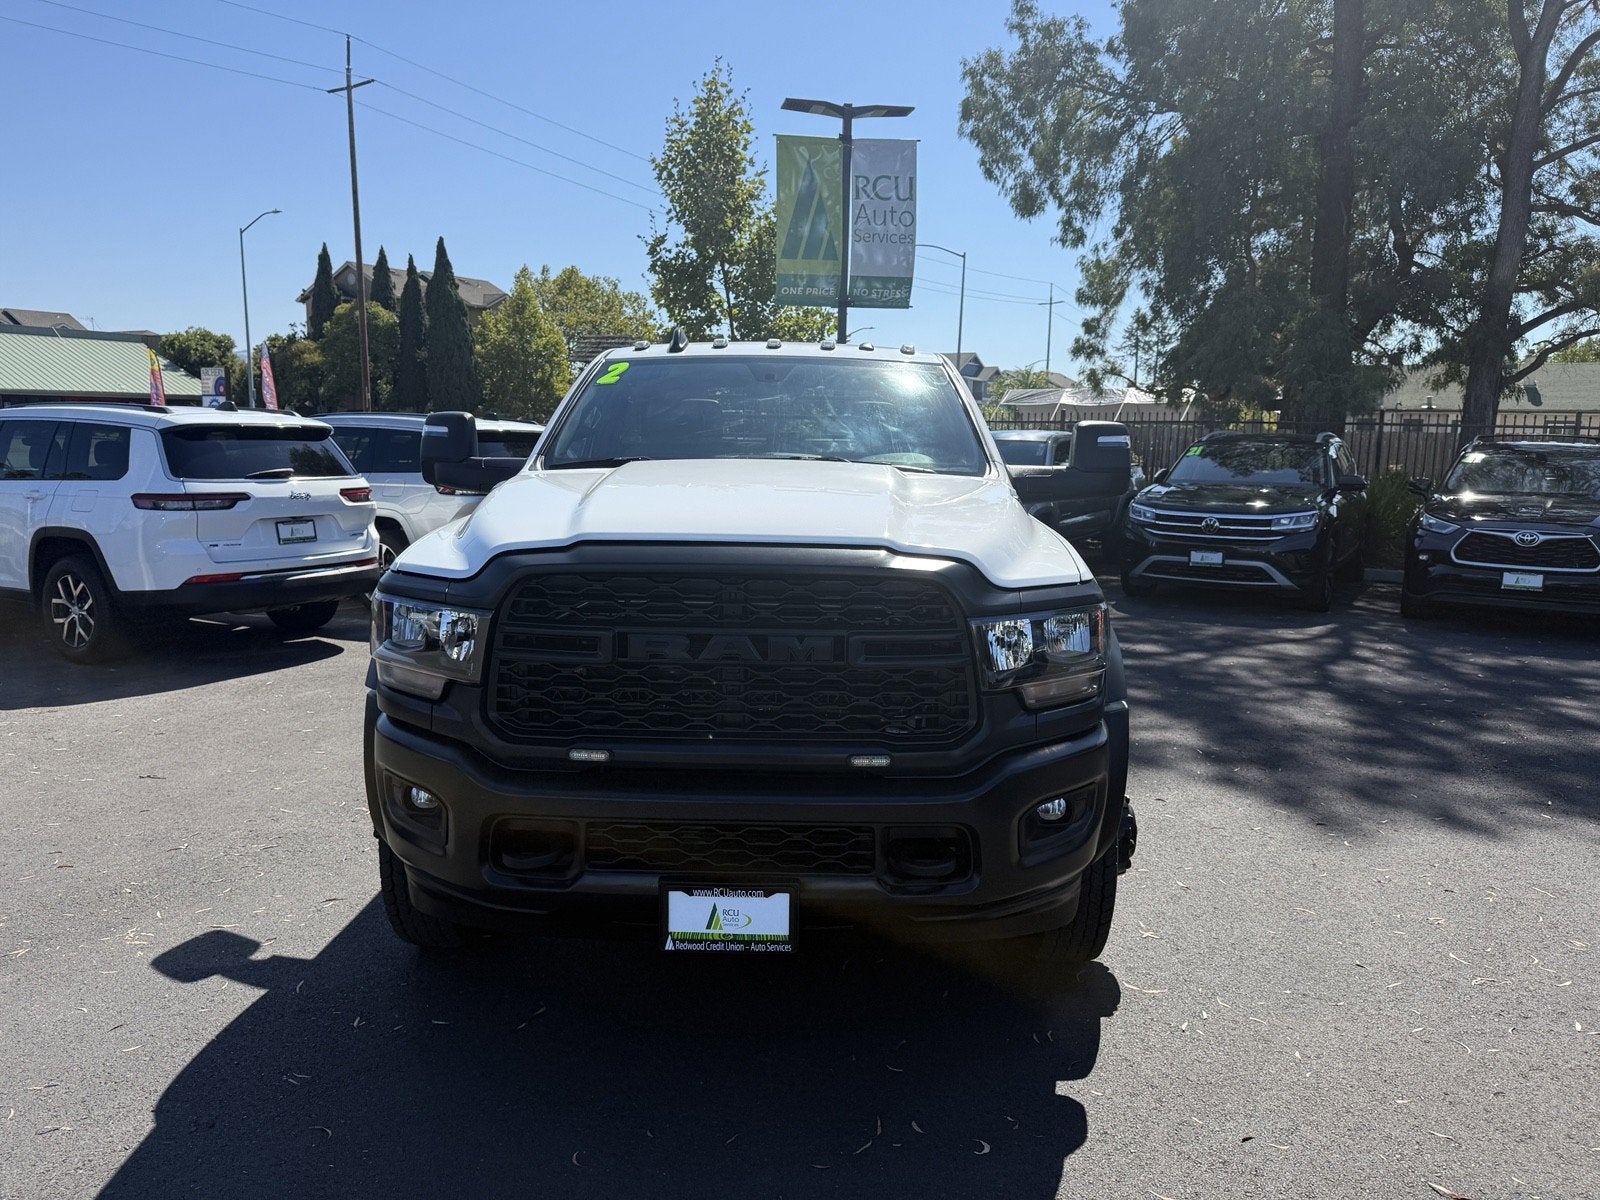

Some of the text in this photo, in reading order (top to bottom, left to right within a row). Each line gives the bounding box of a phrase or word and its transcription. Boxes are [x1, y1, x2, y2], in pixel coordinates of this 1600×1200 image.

[854, 174, 915, 202] RCU
[854, 203, 915, 228] Auto
[854, 228, 914, 245] Services
[781, 286, 836, 296] ONE PRICE
[853, 288, 868, 297] NO
[596, 361, 630, 385] 2
[290, 491, 312, 501] Jeep
[627, 633, 834, 662] RAM
[692, 888, 764, 898] www.RCUauto.com
[722, 909, 740, 917] RCU
[675, 941, 705, 951] Redwood
[706, 941, 725, 951] Credit
[725, 942, 745, 951] Union
[750, 942, 765, 952] Auto
[766, 942, 792, 952] Services
